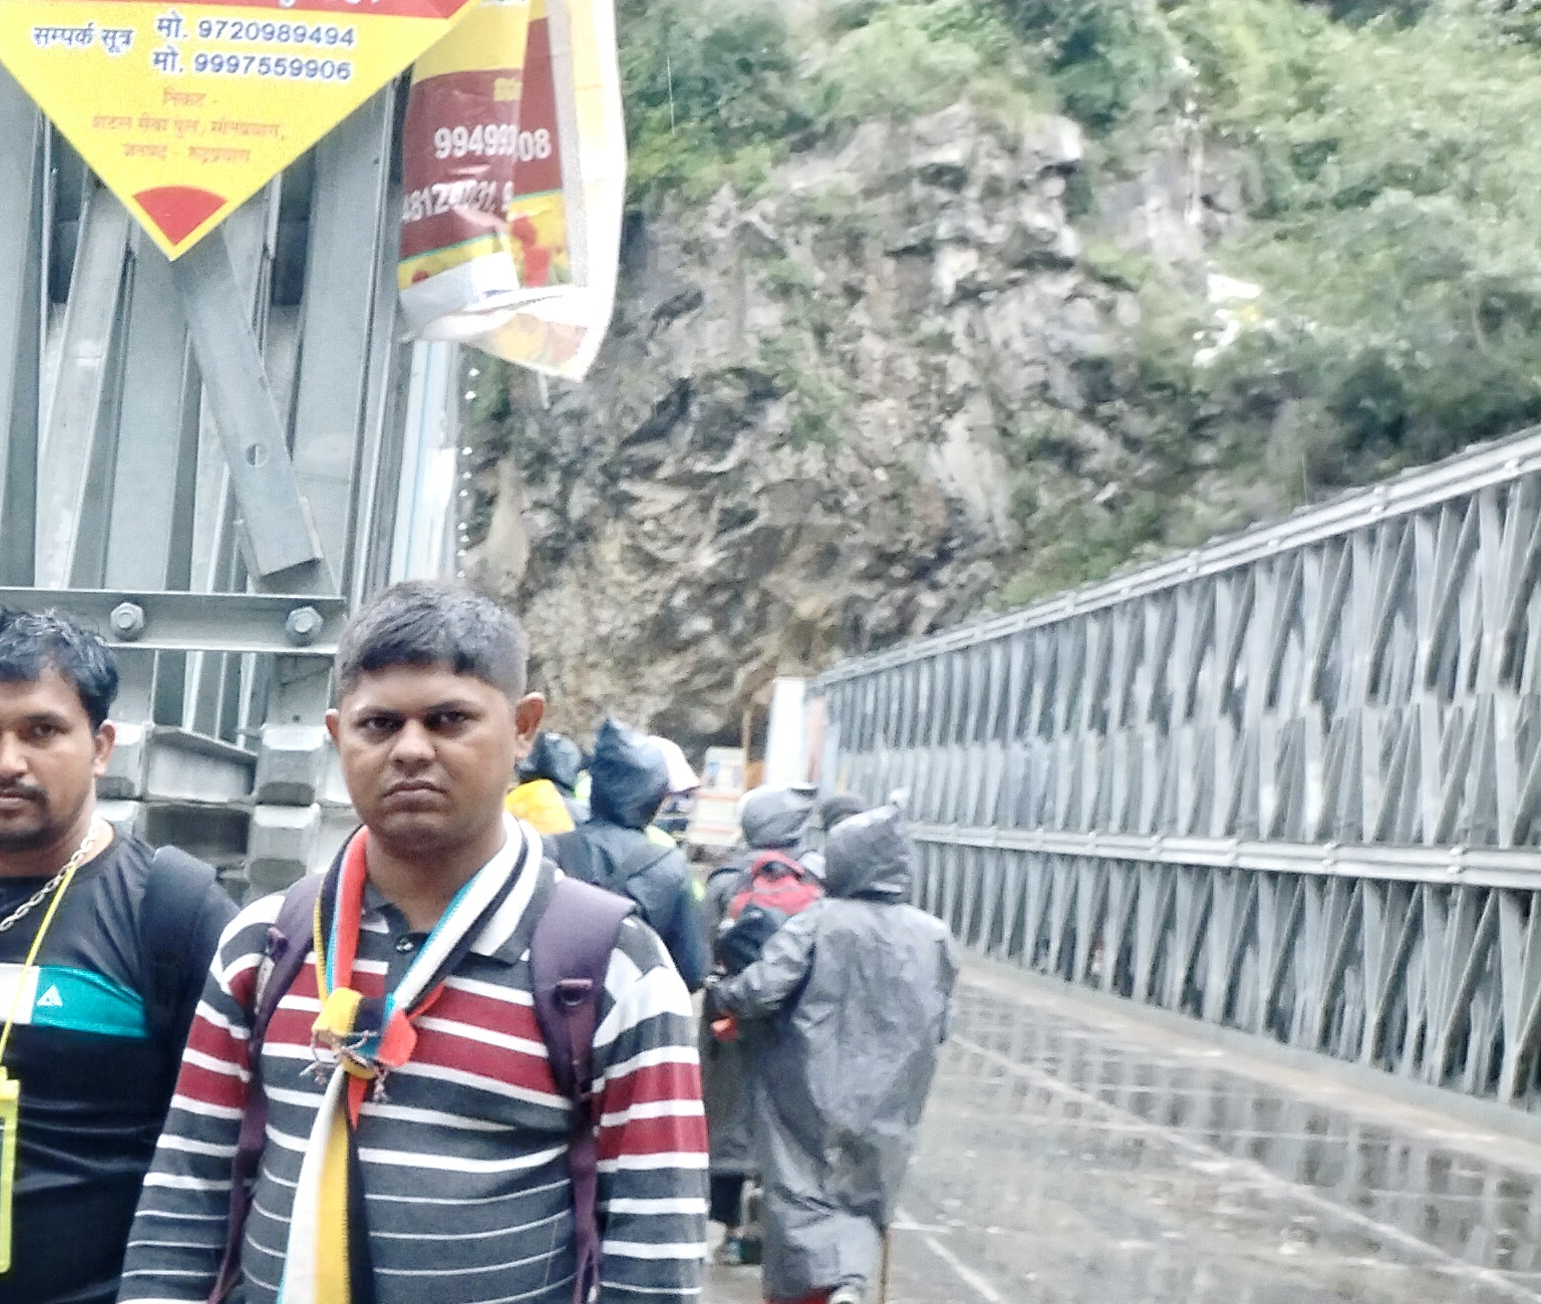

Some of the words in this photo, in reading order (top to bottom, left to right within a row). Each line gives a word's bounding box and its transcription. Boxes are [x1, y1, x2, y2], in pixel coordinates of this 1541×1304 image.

[33, 22, 95, 46] सम्पर्क
[101, 27, 135, 54] सूत्र
[198, 18, 355, 47] 9720989494
[194, 52, 352, 80] 9997559906
